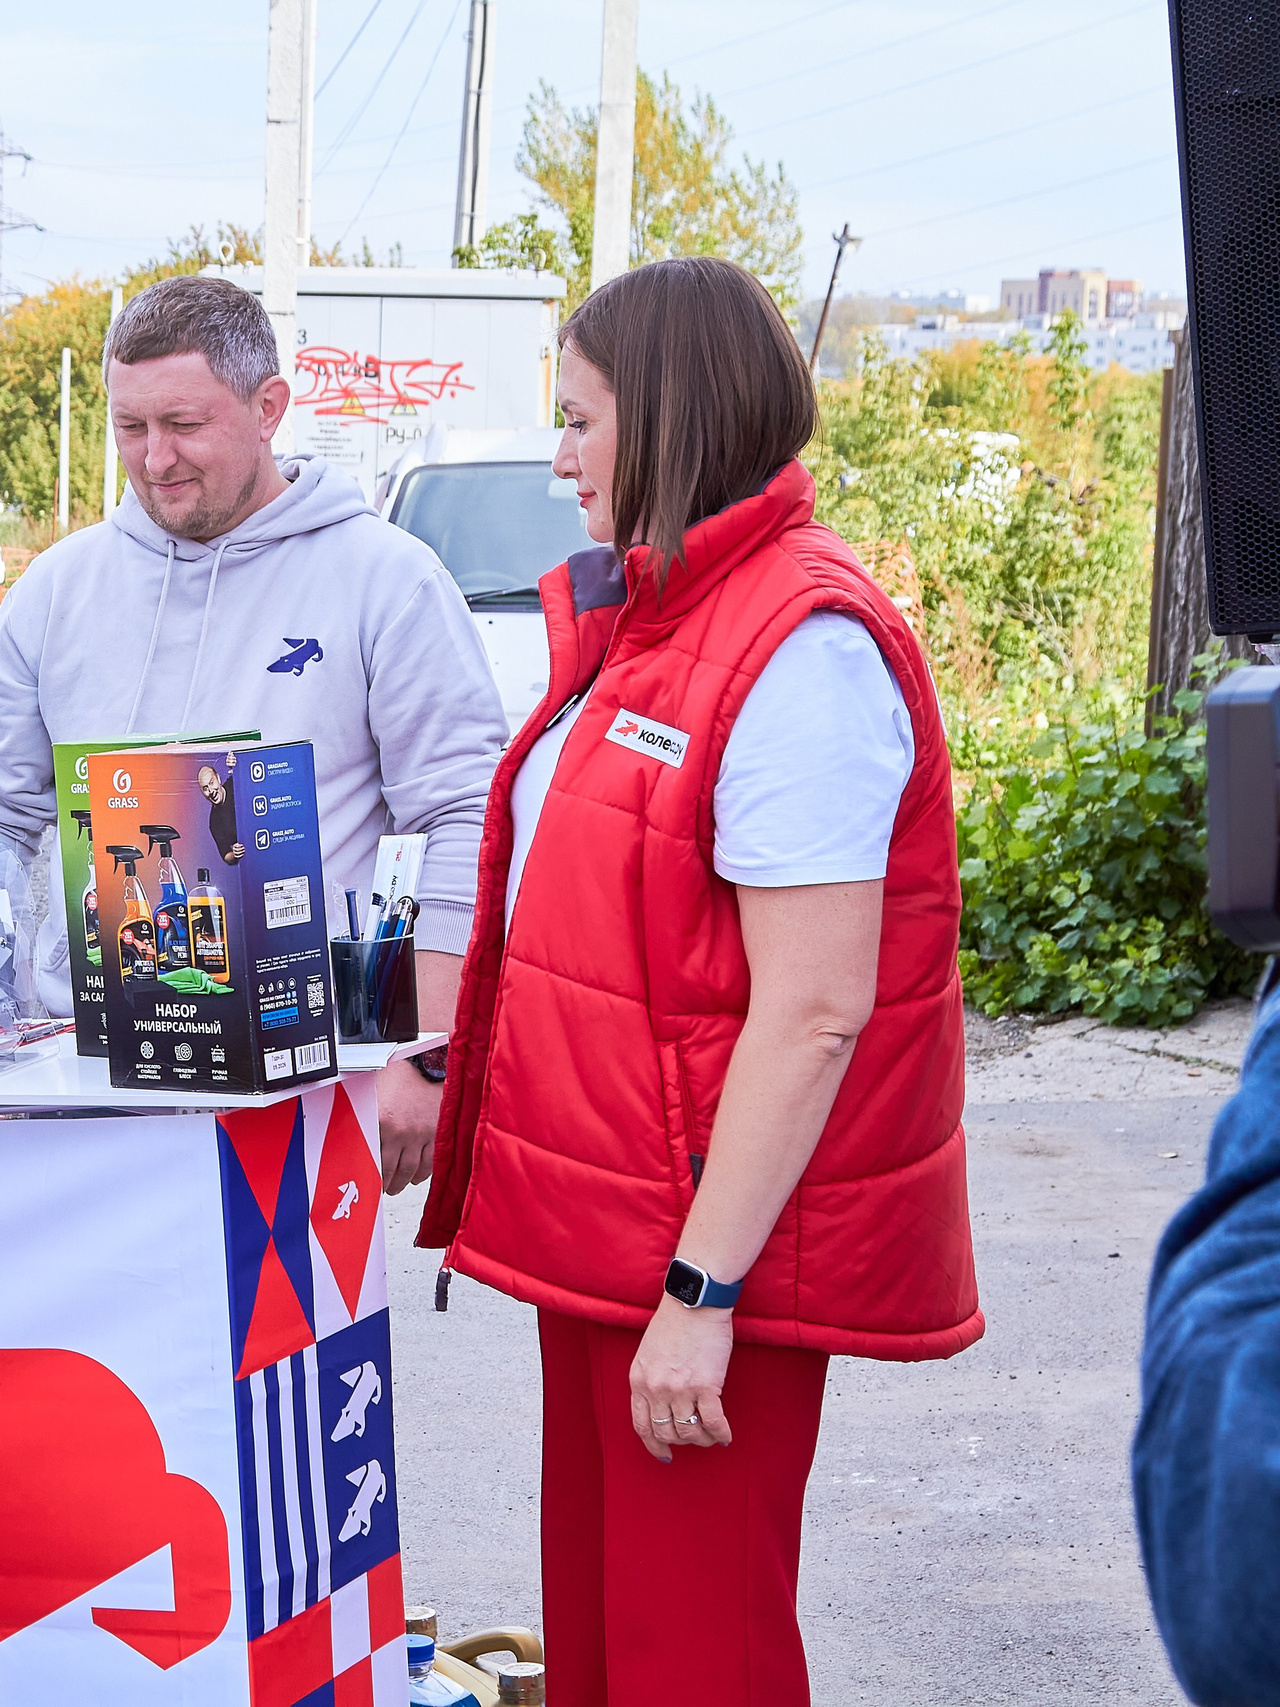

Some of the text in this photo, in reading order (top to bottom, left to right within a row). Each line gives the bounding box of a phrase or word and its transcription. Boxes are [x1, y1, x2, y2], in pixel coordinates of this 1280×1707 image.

[107, 797, 139, 808] GRASS
[80, 992, 91, 1002] ЗА
[155, 1003, 198, 1018] НАБОР
[133, 1019, 222, 1035] УНИВЕРСАЛЬНЫЙ
